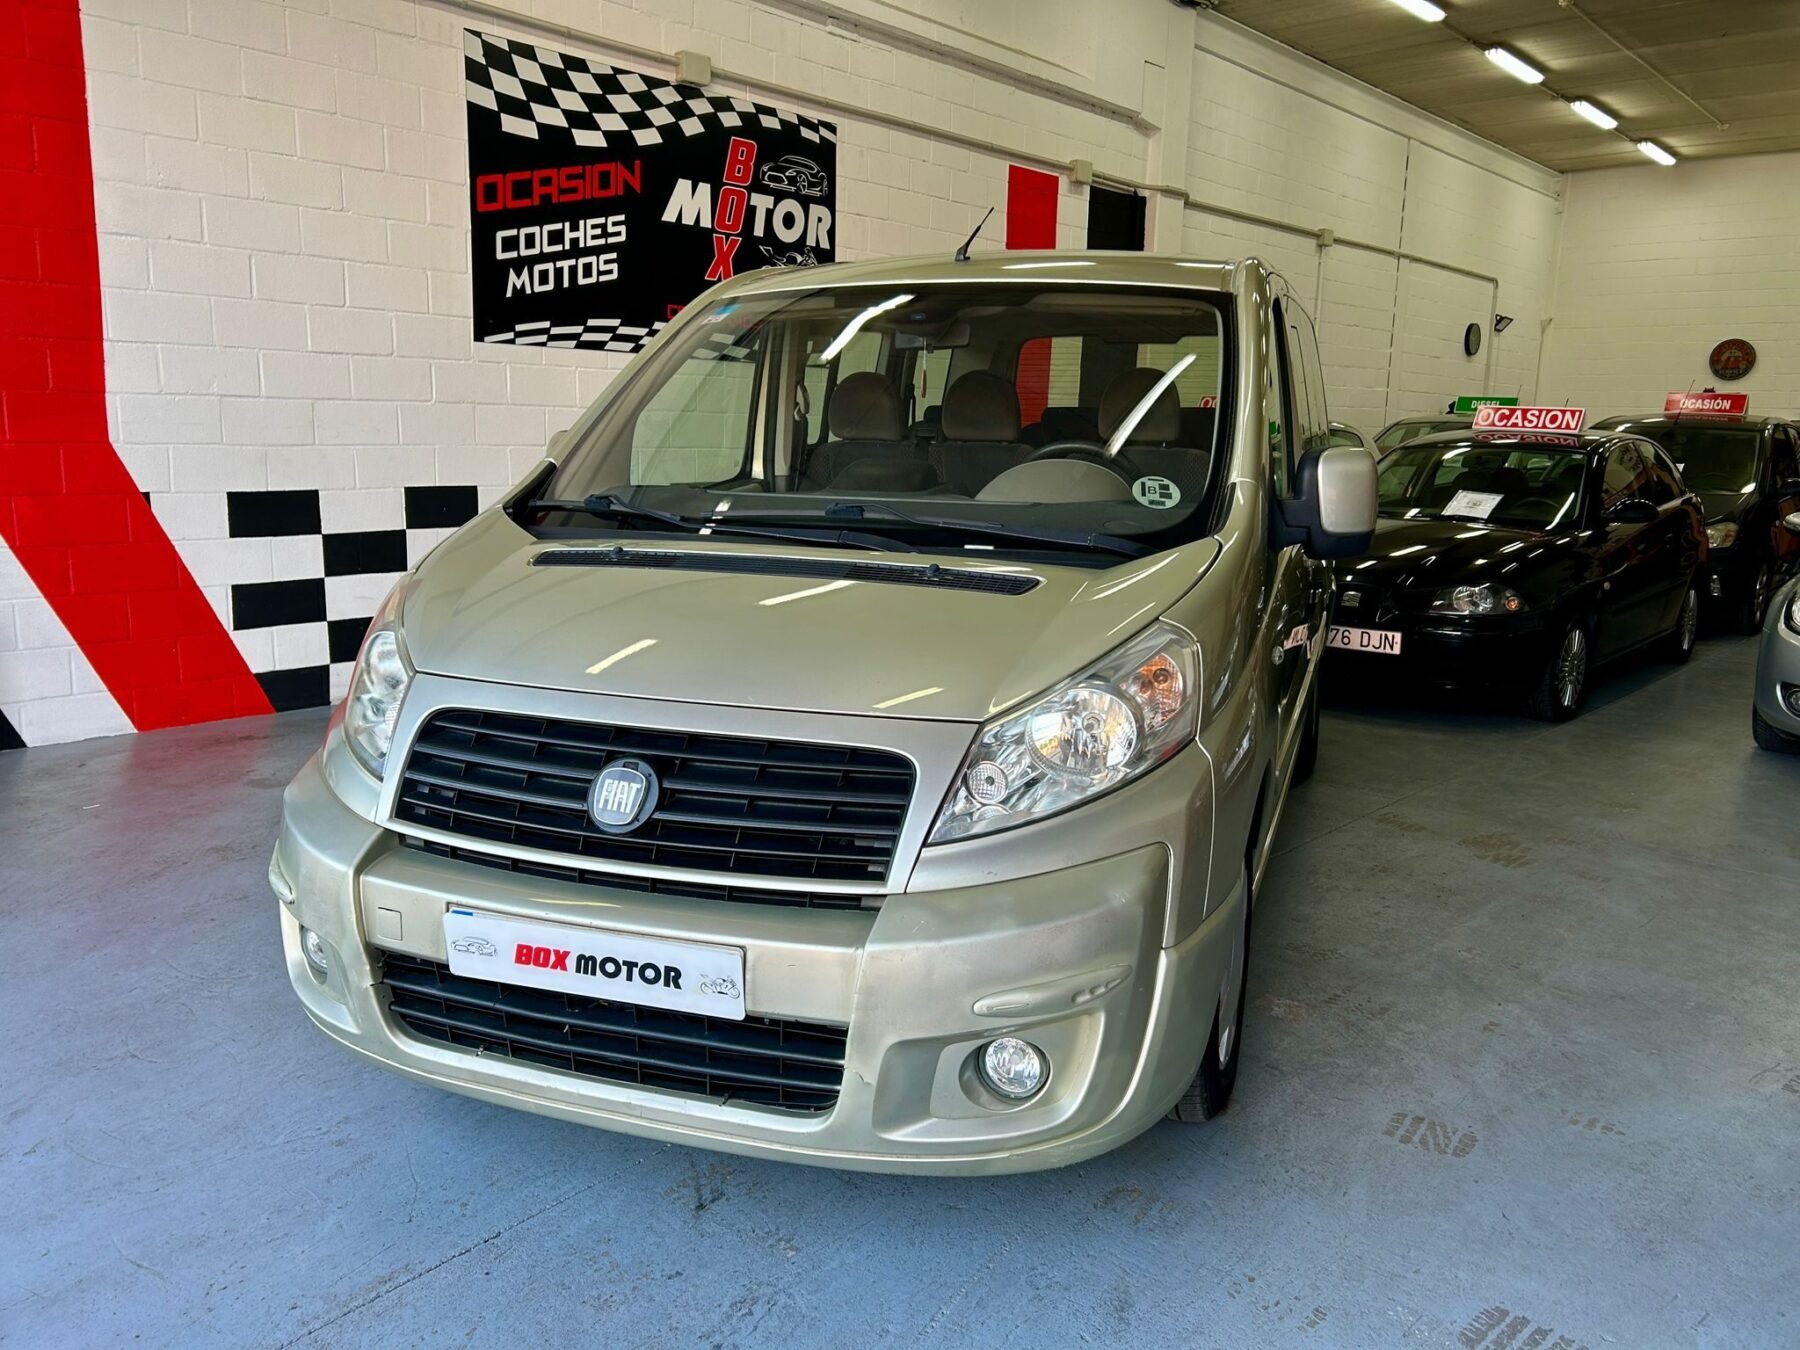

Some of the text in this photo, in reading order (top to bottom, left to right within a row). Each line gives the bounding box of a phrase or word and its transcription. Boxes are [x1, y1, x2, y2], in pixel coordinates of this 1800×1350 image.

[476, 159, 641, 213] OCASION
[495, 214, 627, 260] COCHES
[505, 252, 619, 298] MOTOS
[1478, 408, 1580, 429] OCASION
[1680, 397, 1731, 410] OCASIÓN
[1148, 486, 1157, 495] B
[1360, 631, 1395, 652] DJN
[599, 779, 641, 813] FIAT
[514, 943, 682, 990] BOX MOTOR
